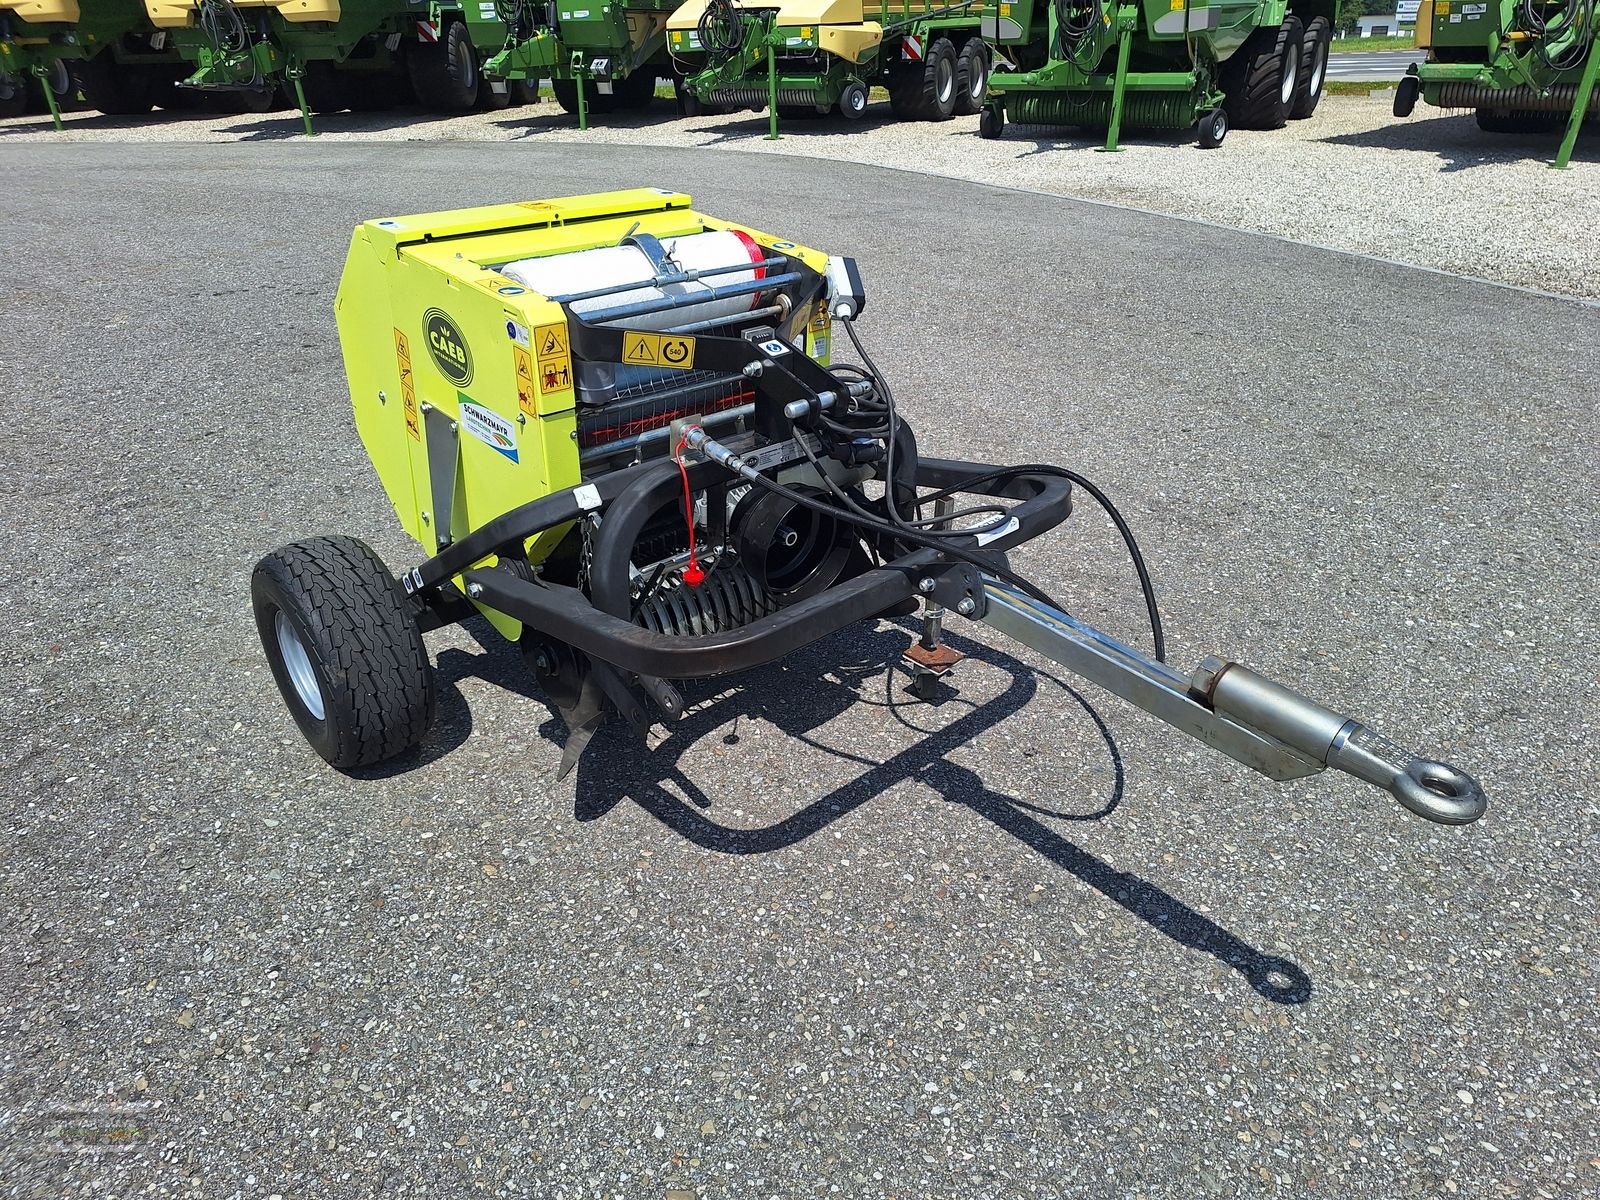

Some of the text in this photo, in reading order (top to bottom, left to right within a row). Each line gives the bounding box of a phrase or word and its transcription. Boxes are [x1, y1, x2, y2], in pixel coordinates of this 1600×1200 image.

[430, 331, 466, 364] CAEB
[669, 348, 682, 356] 540
[463, 403, 508, 436] SCHWARZMAYR
